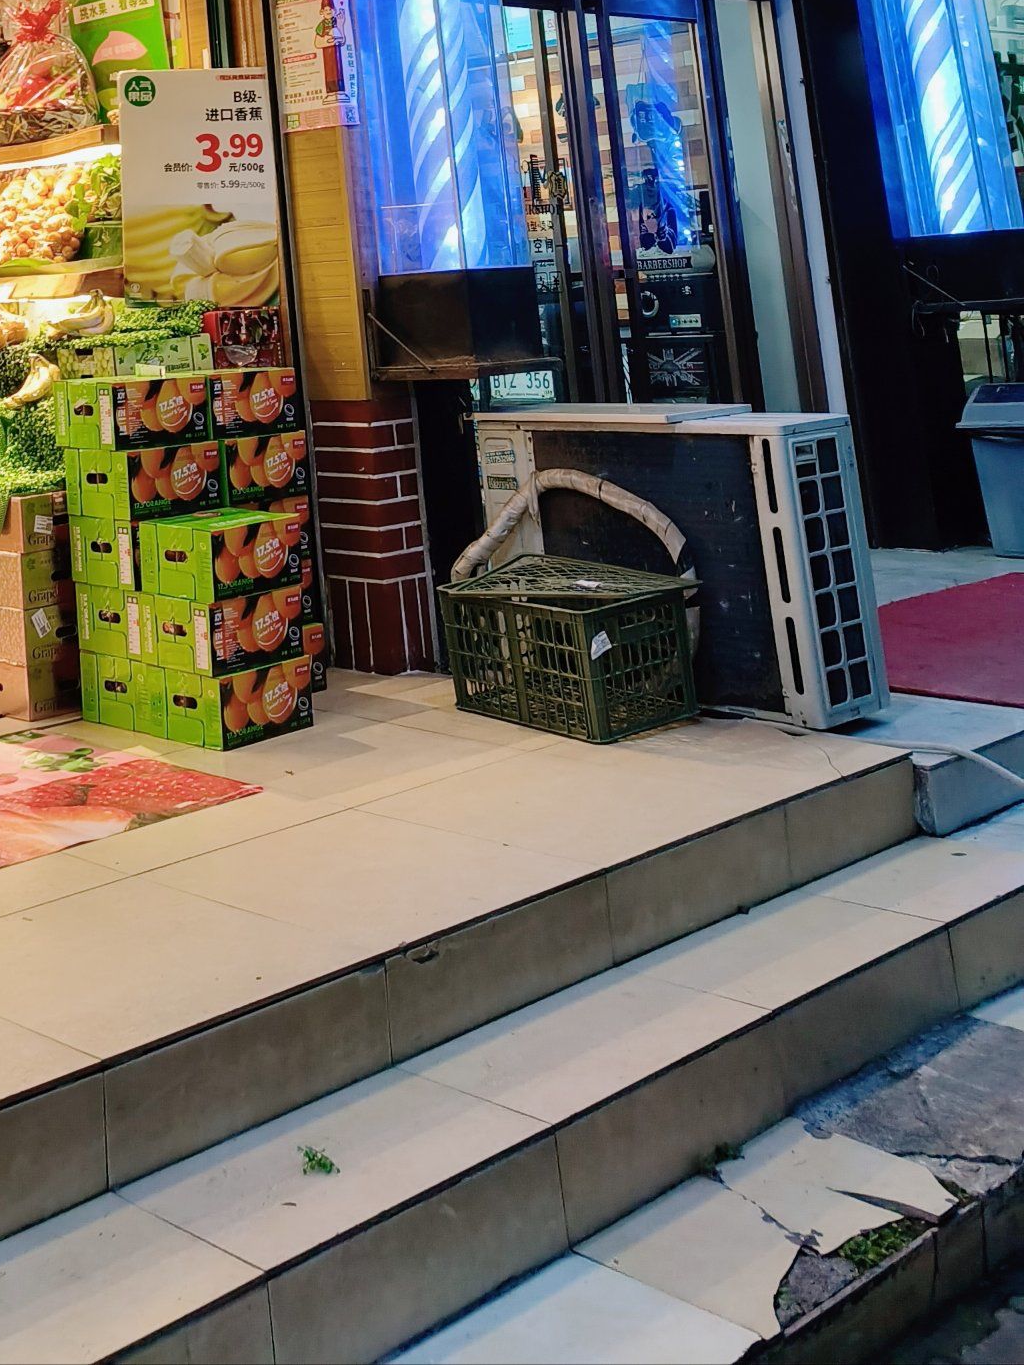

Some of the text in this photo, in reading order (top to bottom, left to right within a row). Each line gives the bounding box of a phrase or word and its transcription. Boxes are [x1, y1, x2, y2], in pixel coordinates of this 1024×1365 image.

[205, 107, 263, 122] 进口香蕉
[163, 133, 265, 174] 会员价: 3.99 元/500g
[637, 256, 689, 271] BARBERSHOP
[525, 372, 550, 389] 356
